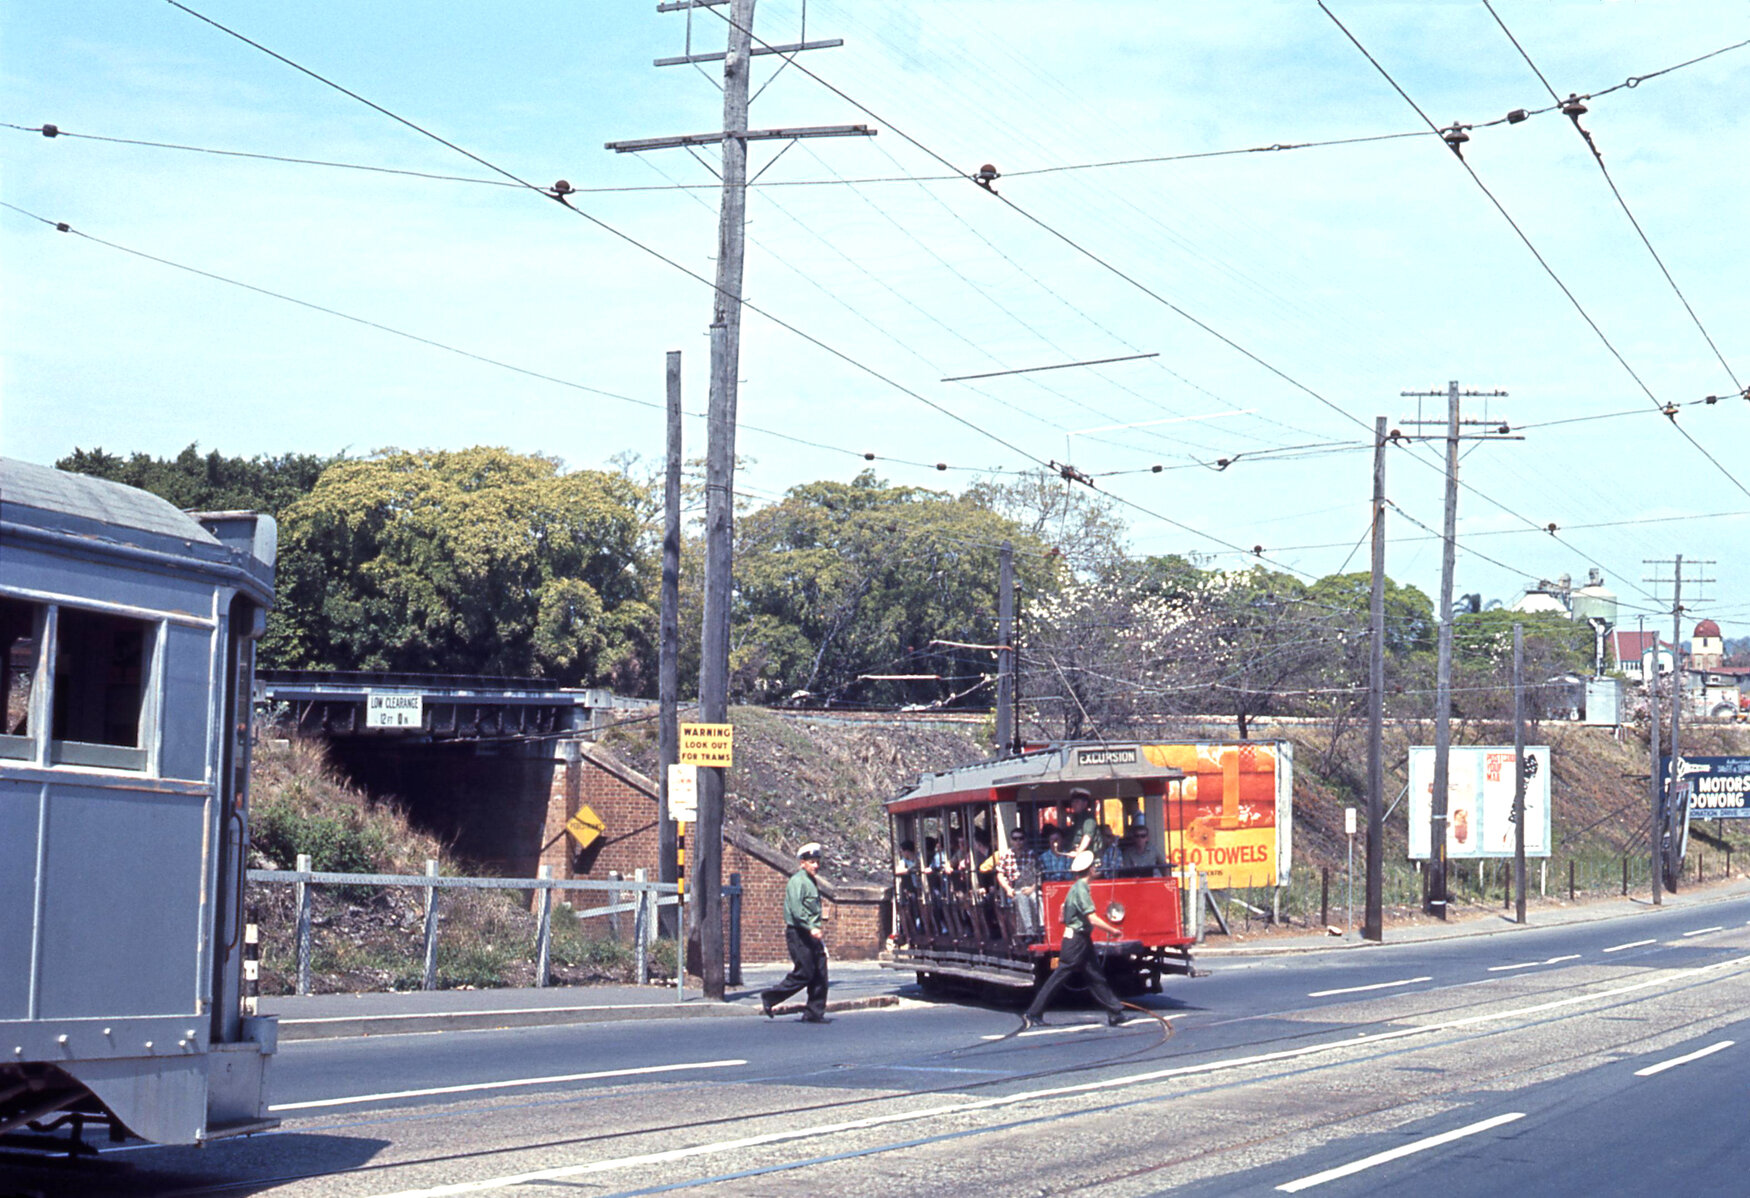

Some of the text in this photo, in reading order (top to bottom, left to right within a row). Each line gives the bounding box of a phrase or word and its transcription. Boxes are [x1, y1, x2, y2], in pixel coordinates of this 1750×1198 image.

[371, 697, 418, 709] LOW CLEARANCE
[684, 728, 730, 737] WARNING
[682, 752, 730, 761] FOR TRAMS
[1080, 751, 1135, 765] EXCURSION
[1699, 776, 1750, 792] MOTORS
[1205, 844, 1268, 865] TOWELS
